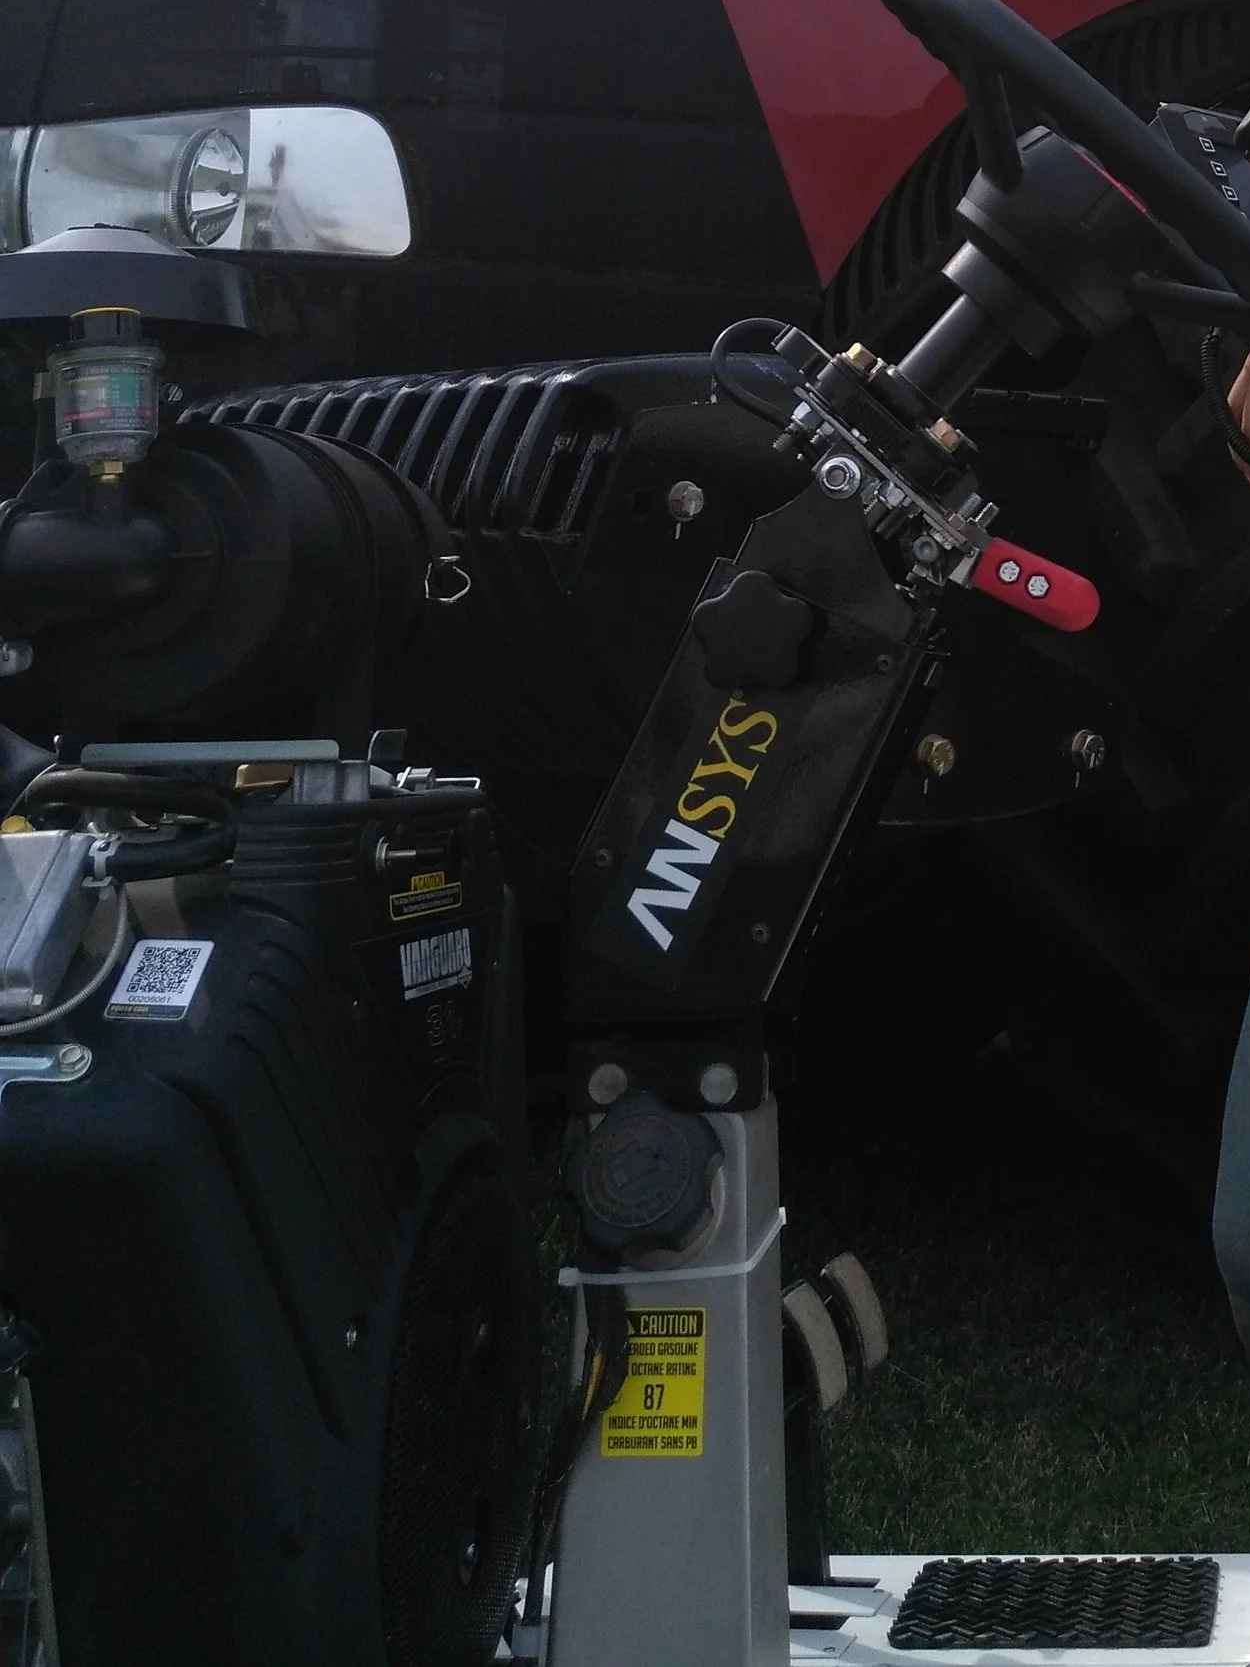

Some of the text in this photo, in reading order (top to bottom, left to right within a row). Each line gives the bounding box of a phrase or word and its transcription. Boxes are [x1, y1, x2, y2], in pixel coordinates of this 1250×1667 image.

[640, 1315, 698, 1335] CAUTION
[628, 1342, 699, 1356] EADED GASOLINE
[631, 1363, 697, 1376] OCTANE RATING
[643, 1383, 666, 1411] 87
[608, 1415, 698, 1429] INDICE D'OCTANE MIN
[607, 1436, 698, 1450] CARBURANT SANS PB
